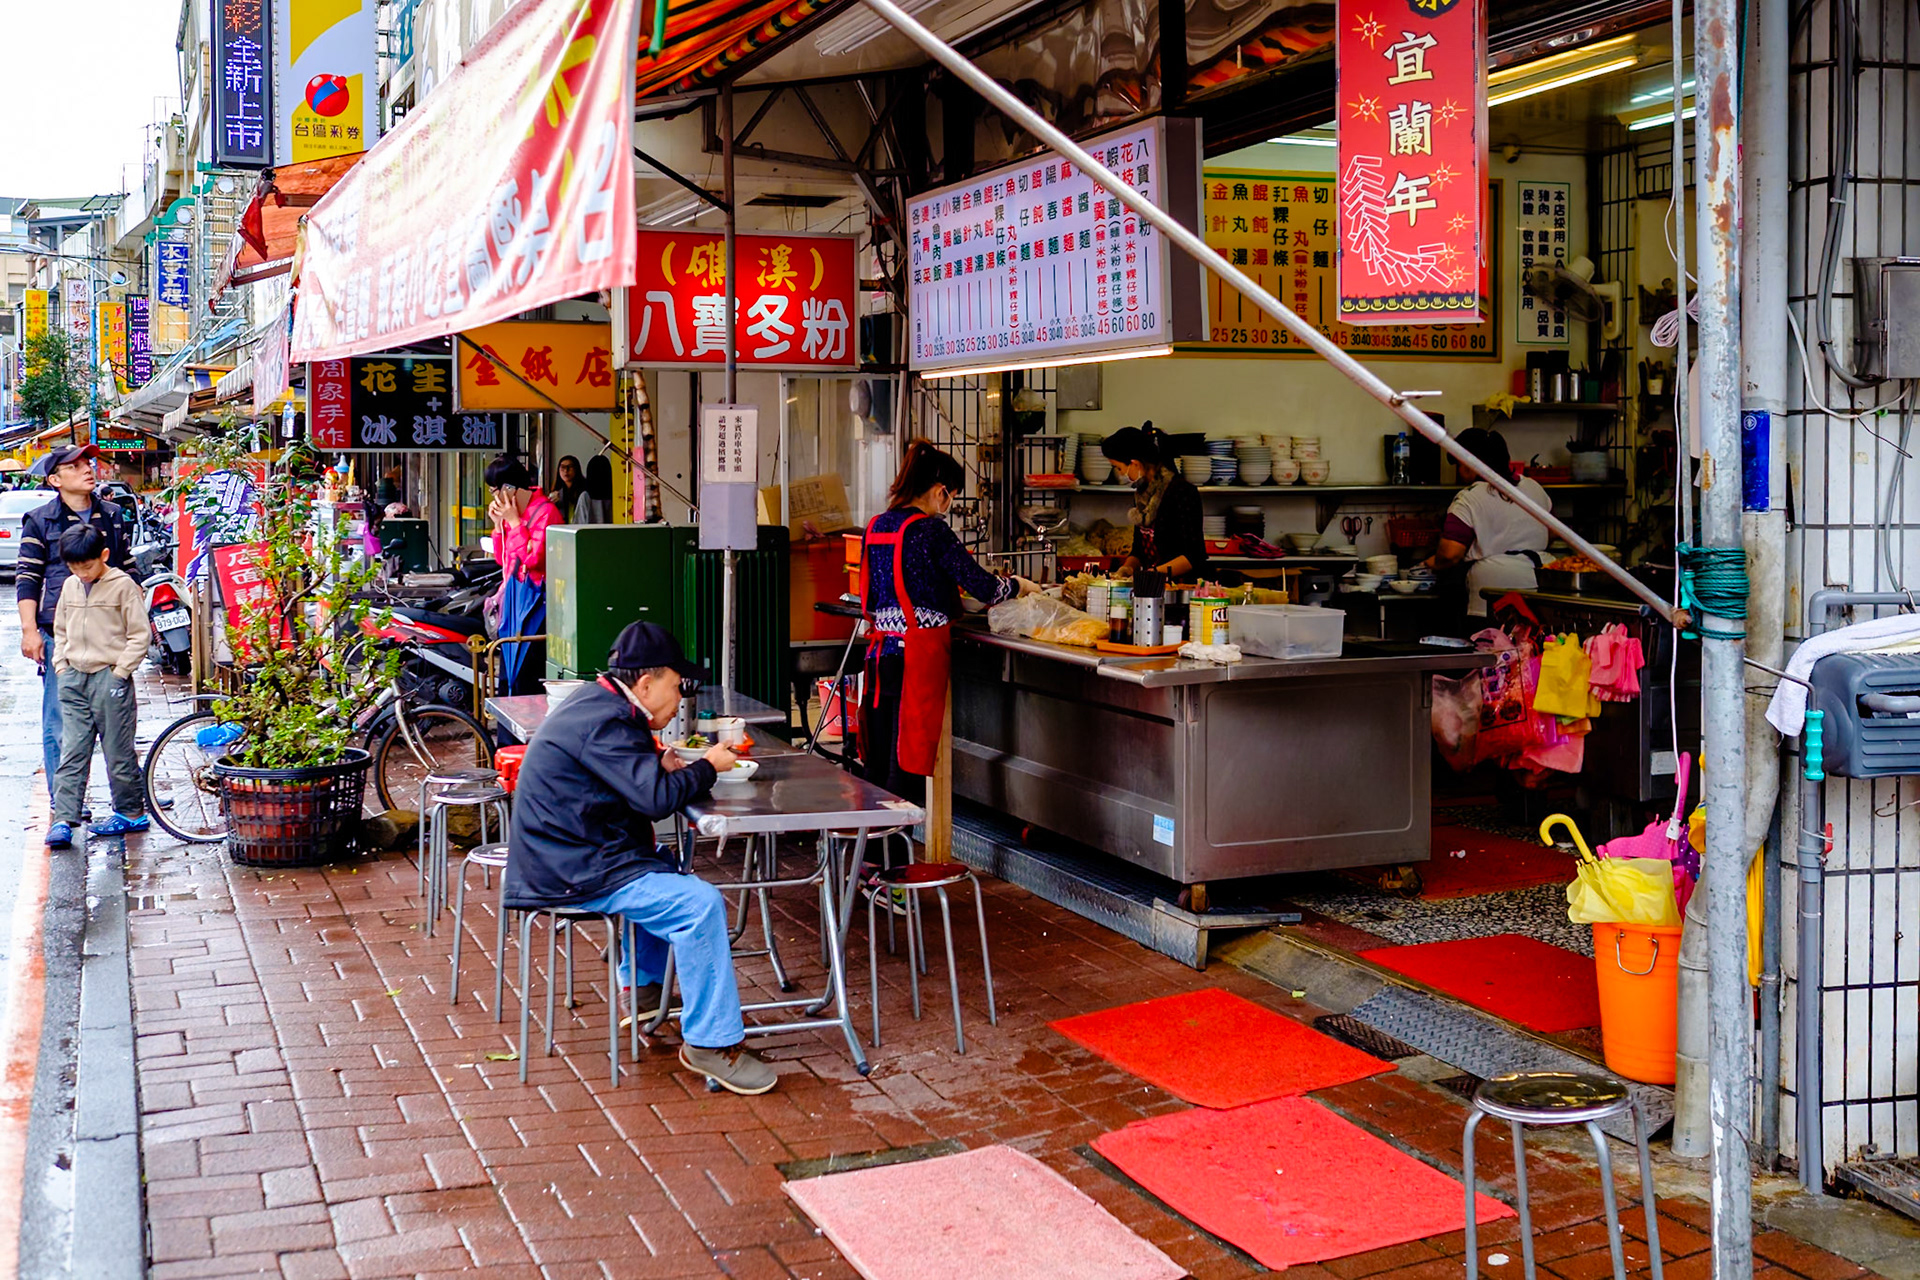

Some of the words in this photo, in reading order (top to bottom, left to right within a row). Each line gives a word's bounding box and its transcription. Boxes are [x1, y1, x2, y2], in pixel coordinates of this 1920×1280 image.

[1383, 31, 1438, 228] 宜蘭年
[1018, 174, 1031, 261] 切仔麵
[1046, 164, 1059, 256] 陽春麵
[973, 189, 984, 272] 魚丸湯
[1232, 183, 1248, 266] 魚丸湯
[1313, 187, 1329, 268] 切仔麵
[962, 192, 973, 274] 金針湯
[634, 290, 849, 360] 八寶冬粉
[1098, 318, 1109, 334] 45
[1112, 316, 1124, 333] 60
[1126, 314, 1139, 332] 60
[1142, 312, 1154, 331] 80
[987, 334, 997, 349] 30
[998, 333, 1008, 347] 35
[1009, 331, 1020, 345] 45
[1036, 327, 1047, 342] 45
[1212, 328, 1228, 342] 25
[1231, 328, 1248, 343] 25
[1251, 329, 1268, 343] 30
[1271, 330, 1288, 344] 35
[1332, 331, 1348, 345] 45
[1412, 334, 1428, 348] 45
[1431, 335, 1447, 349] 60
[1451, 335, 1466, 349] 60
[1470, 335, 1486, 349] 80
[946, 341, 955, 355] 30
[956, 339, 965, 353] 35
[966, 338, 976, 351] 25
[976, 336, 986, 350] 25
[924, 344, 933, 358] 30
[465, 344, 612, 388] 金紙店
[360, 362, 447, 393] 花生
[318, 360, 345, 446] 周家手作
[361, 414, 497, 446] 冰淇淋
